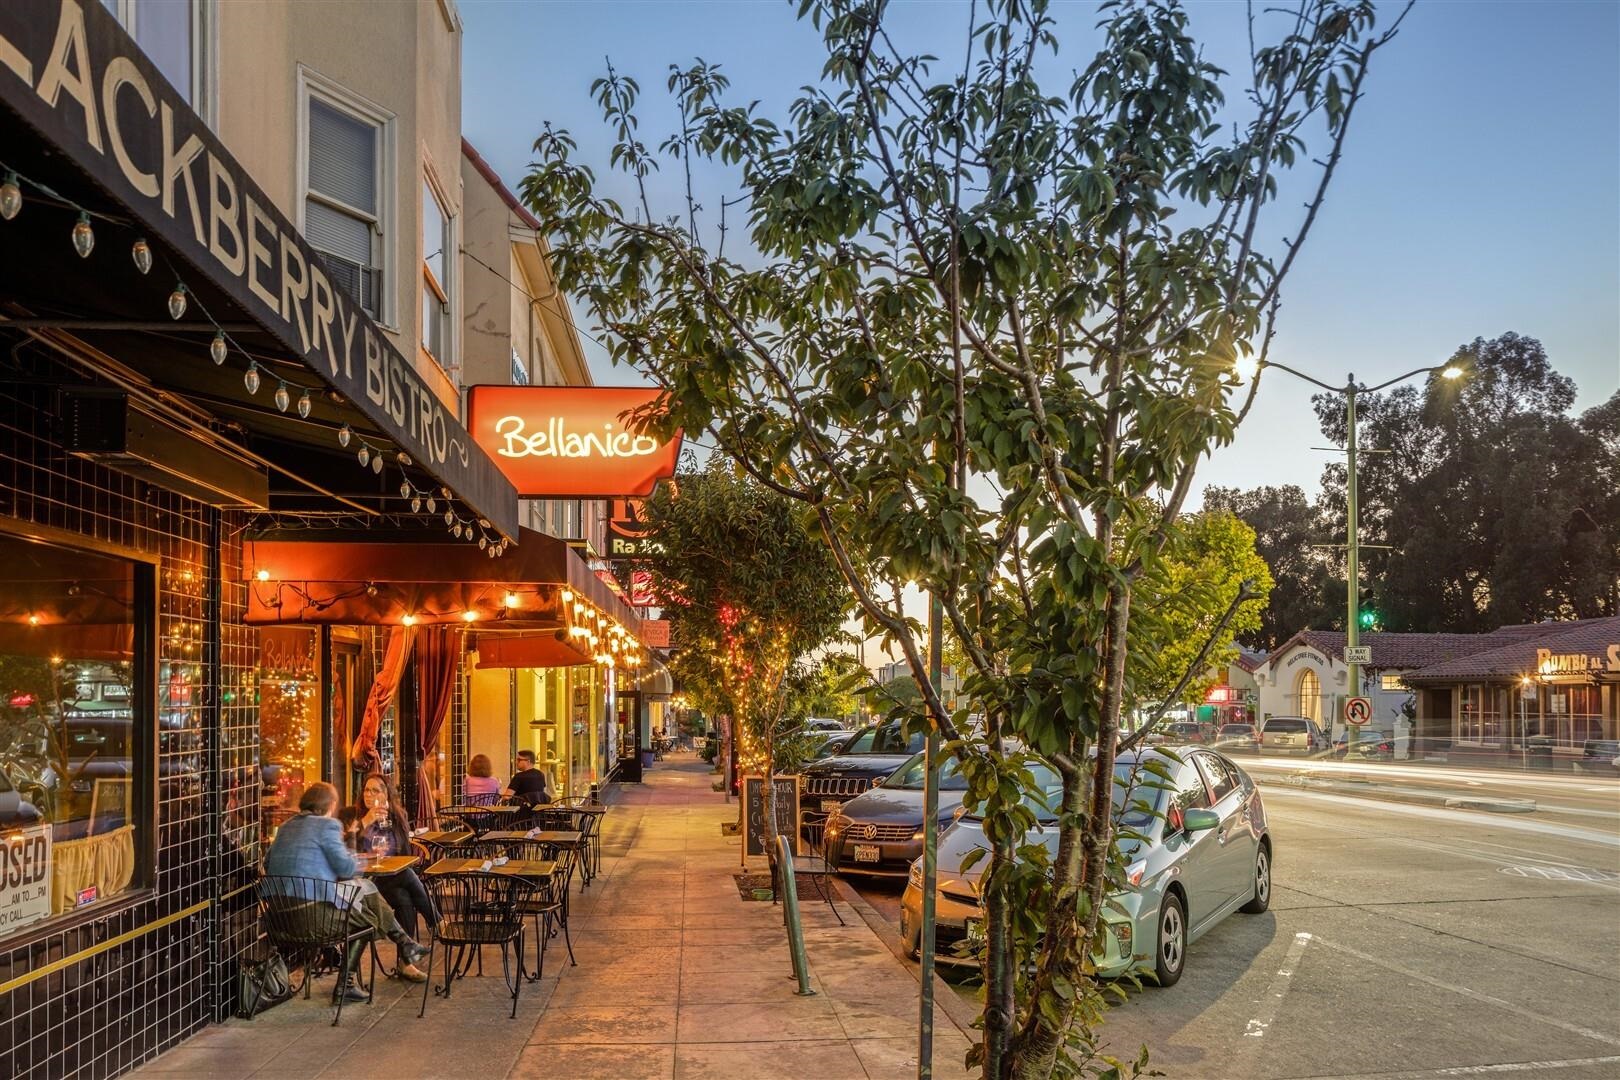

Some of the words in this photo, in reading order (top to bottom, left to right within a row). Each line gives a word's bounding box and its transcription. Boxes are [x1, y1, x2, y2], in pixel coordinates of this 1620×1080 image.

[365, 326, 447, 464] BISTRO
[495, 415, 658, 458] Bellanico
[1536, 648, 1588, 674] RUMBO
[1591, 657, 1603, 669] AL
[11, 892, 20, 905] AM
[22, 889, 30, 903] TO
[37, 885, 46, 897] PM
[9, 908, 24, 922] CALL
